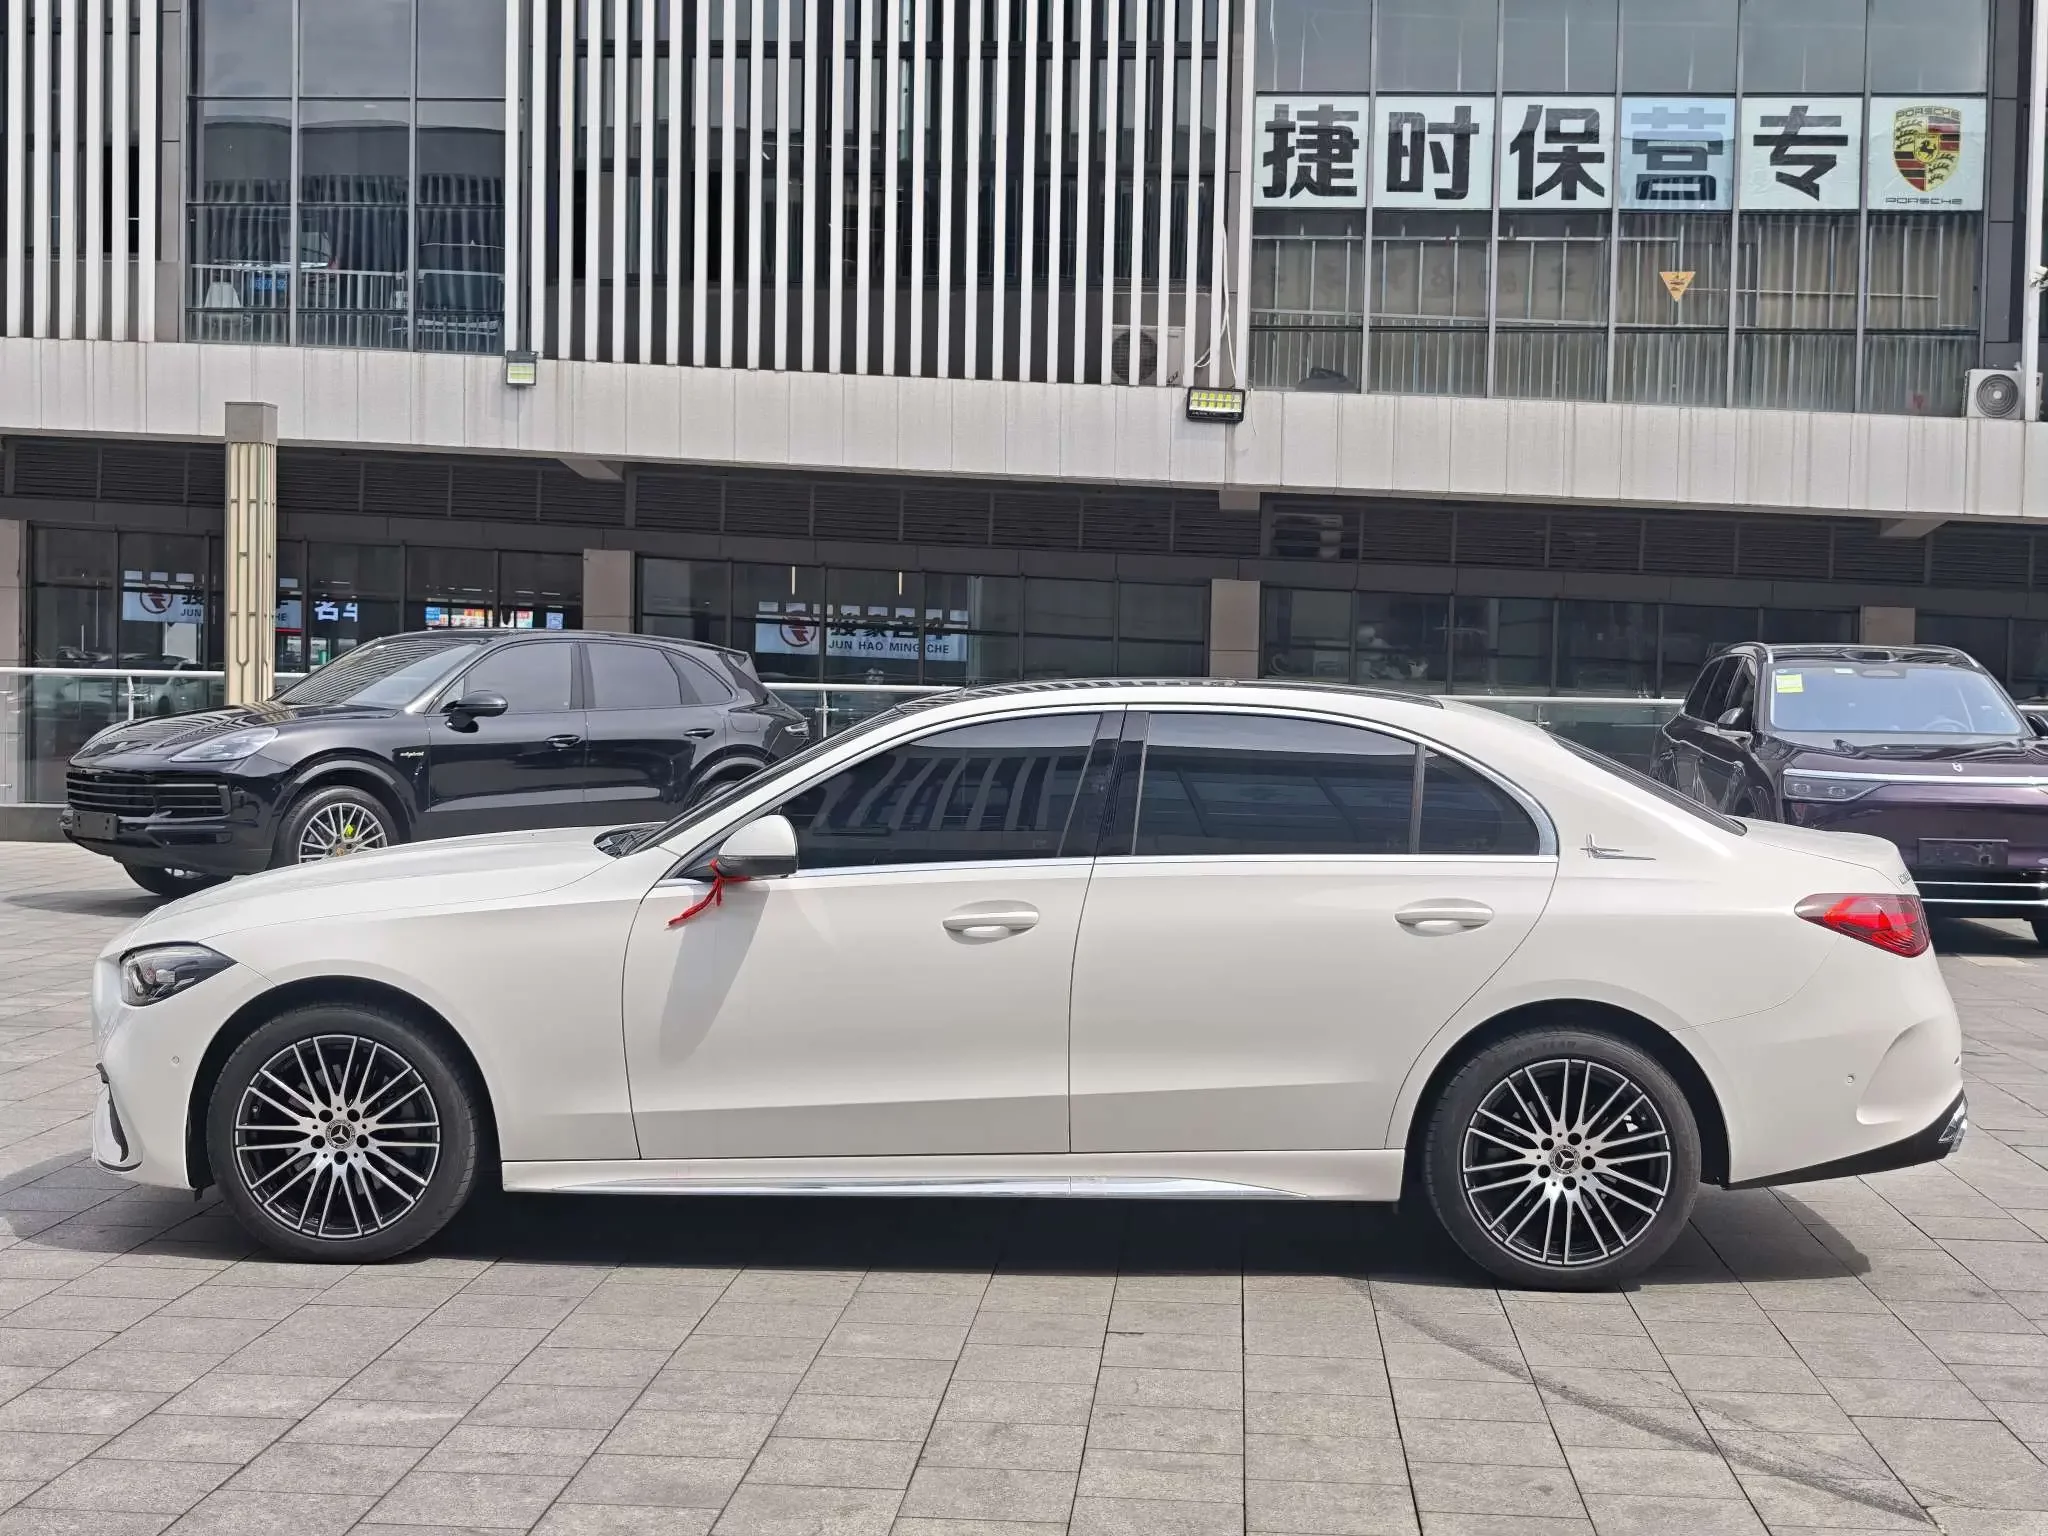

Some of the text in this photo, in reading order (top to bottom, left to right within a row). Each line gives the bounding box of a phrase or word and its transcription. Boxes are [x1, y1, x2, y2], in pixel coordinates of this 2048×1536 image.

[1885, 197, 1962, 205] PORSCHE
[180, 608, 202, 617] JUN
[828, 640, 950, 654] JUN HAO MING CHE
